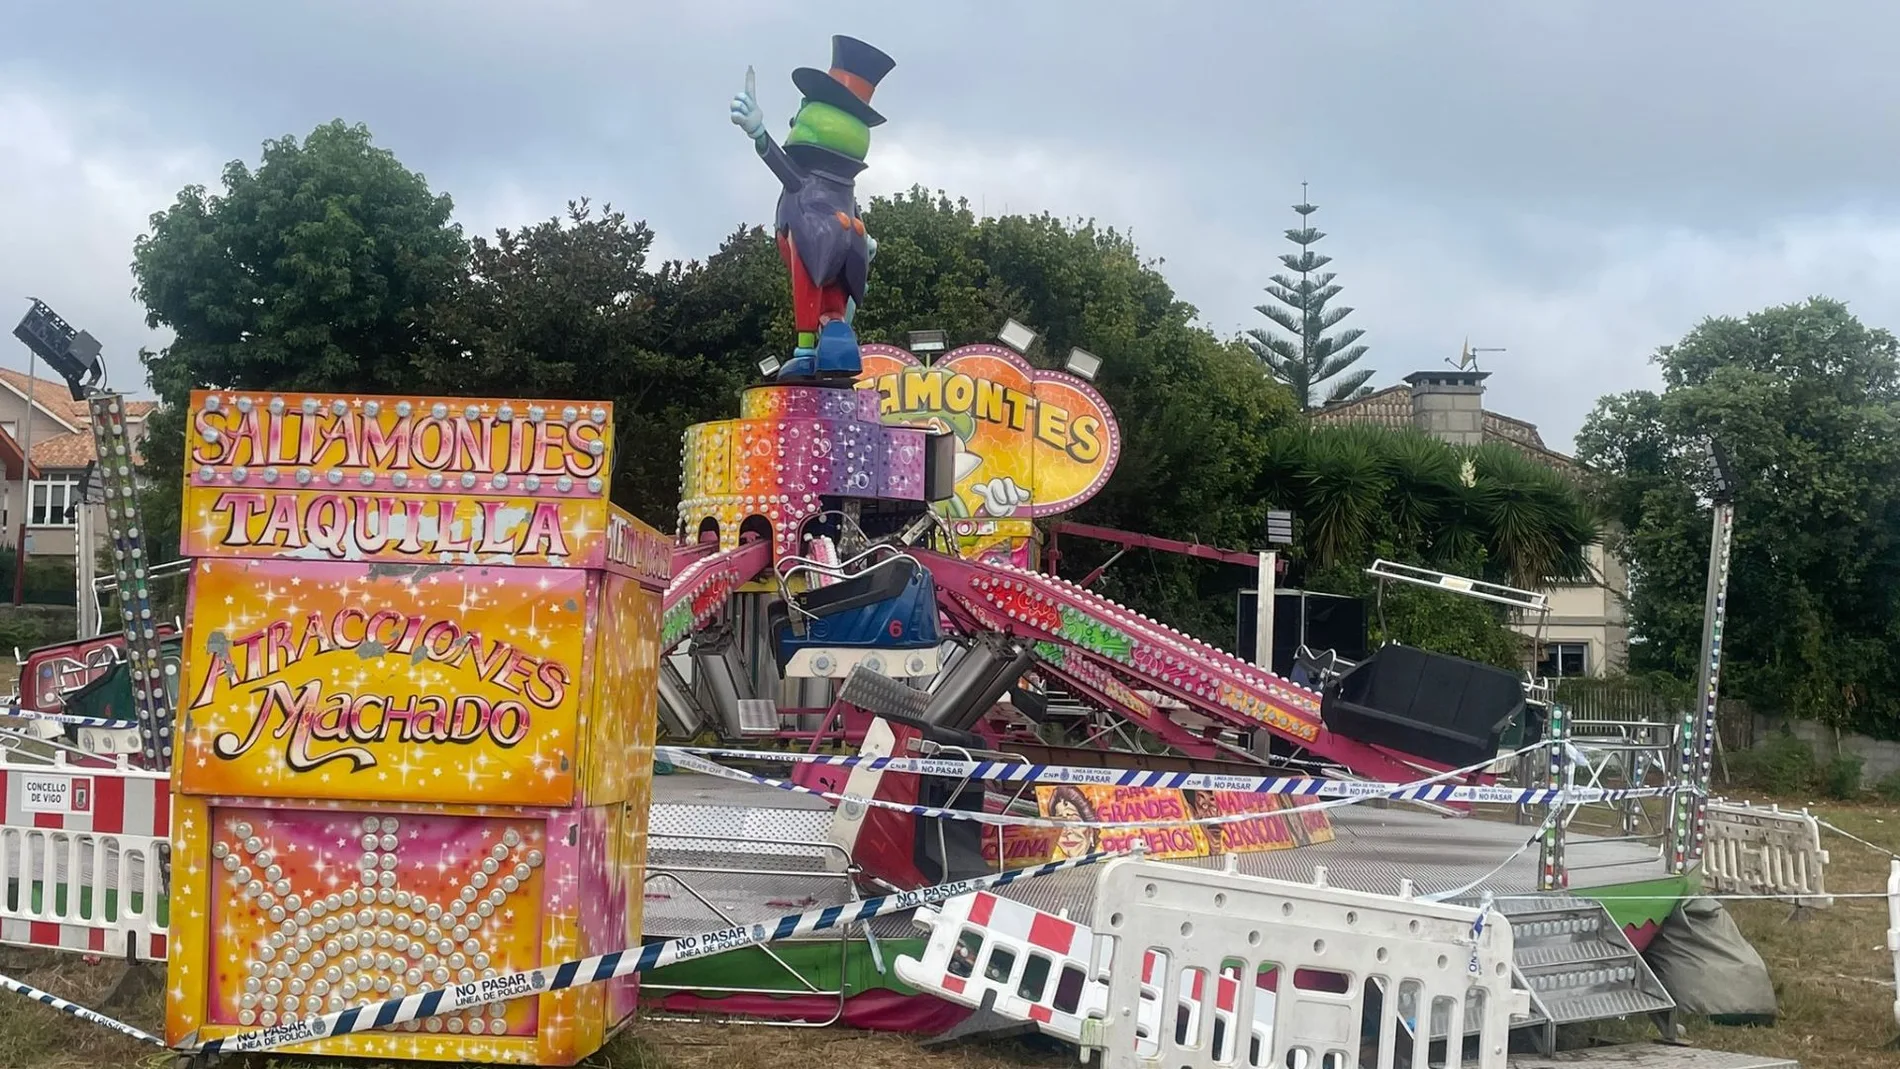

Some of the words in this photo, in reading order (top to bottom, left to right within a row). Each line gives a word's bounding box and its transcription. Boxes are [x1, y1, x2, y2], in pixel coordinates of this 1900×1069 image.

[192, 406, 607, 478] SALTAMONTES
[212, 491, 570, 557] TAQUILLA
[889, 620, 902, 637] 6
[189, 608, 571, 710] ATRACCIONES
[921, 765, 935, 773] NO
[936, 766, 963, 775] PASAR
[1086, 775, 1111, 783] PASAR
[27, 782, 66, 792] CONCELLO
[1226, 782, 1251, 790] PASAR
[31, 793, 41, 802] DE
[43, 794, 61, 803] VIGO
[1096, 798, 1183, 823] GRANDES
[896, 891, 918, 903] NO
[923, 882, 968, 902] PASAR
[675, 948, 701, 959] LINEA
[703, 944, 716, 953] DE
[718, 937, 752, 950] POLICIA
[676, 937, 697, 951] NO
[702, 927, 747, 945] PASAR
[455, 995, 481, 1006] LINEA
[483, 991, 495, 1000] DE
[498, 984, 532, 997] POLICIA
[456, 983, 476, 997] NO
[482, 973, 526, 992] PASAR
[236, 1040, 262, 1051] LINEA
[264, 1036, 277, 1046] DE
[279, 1029, 313, 1042] POLICIA
[237, 1030, 258, 1042] NO
[263, 1020, 307, 1037] PASAR
